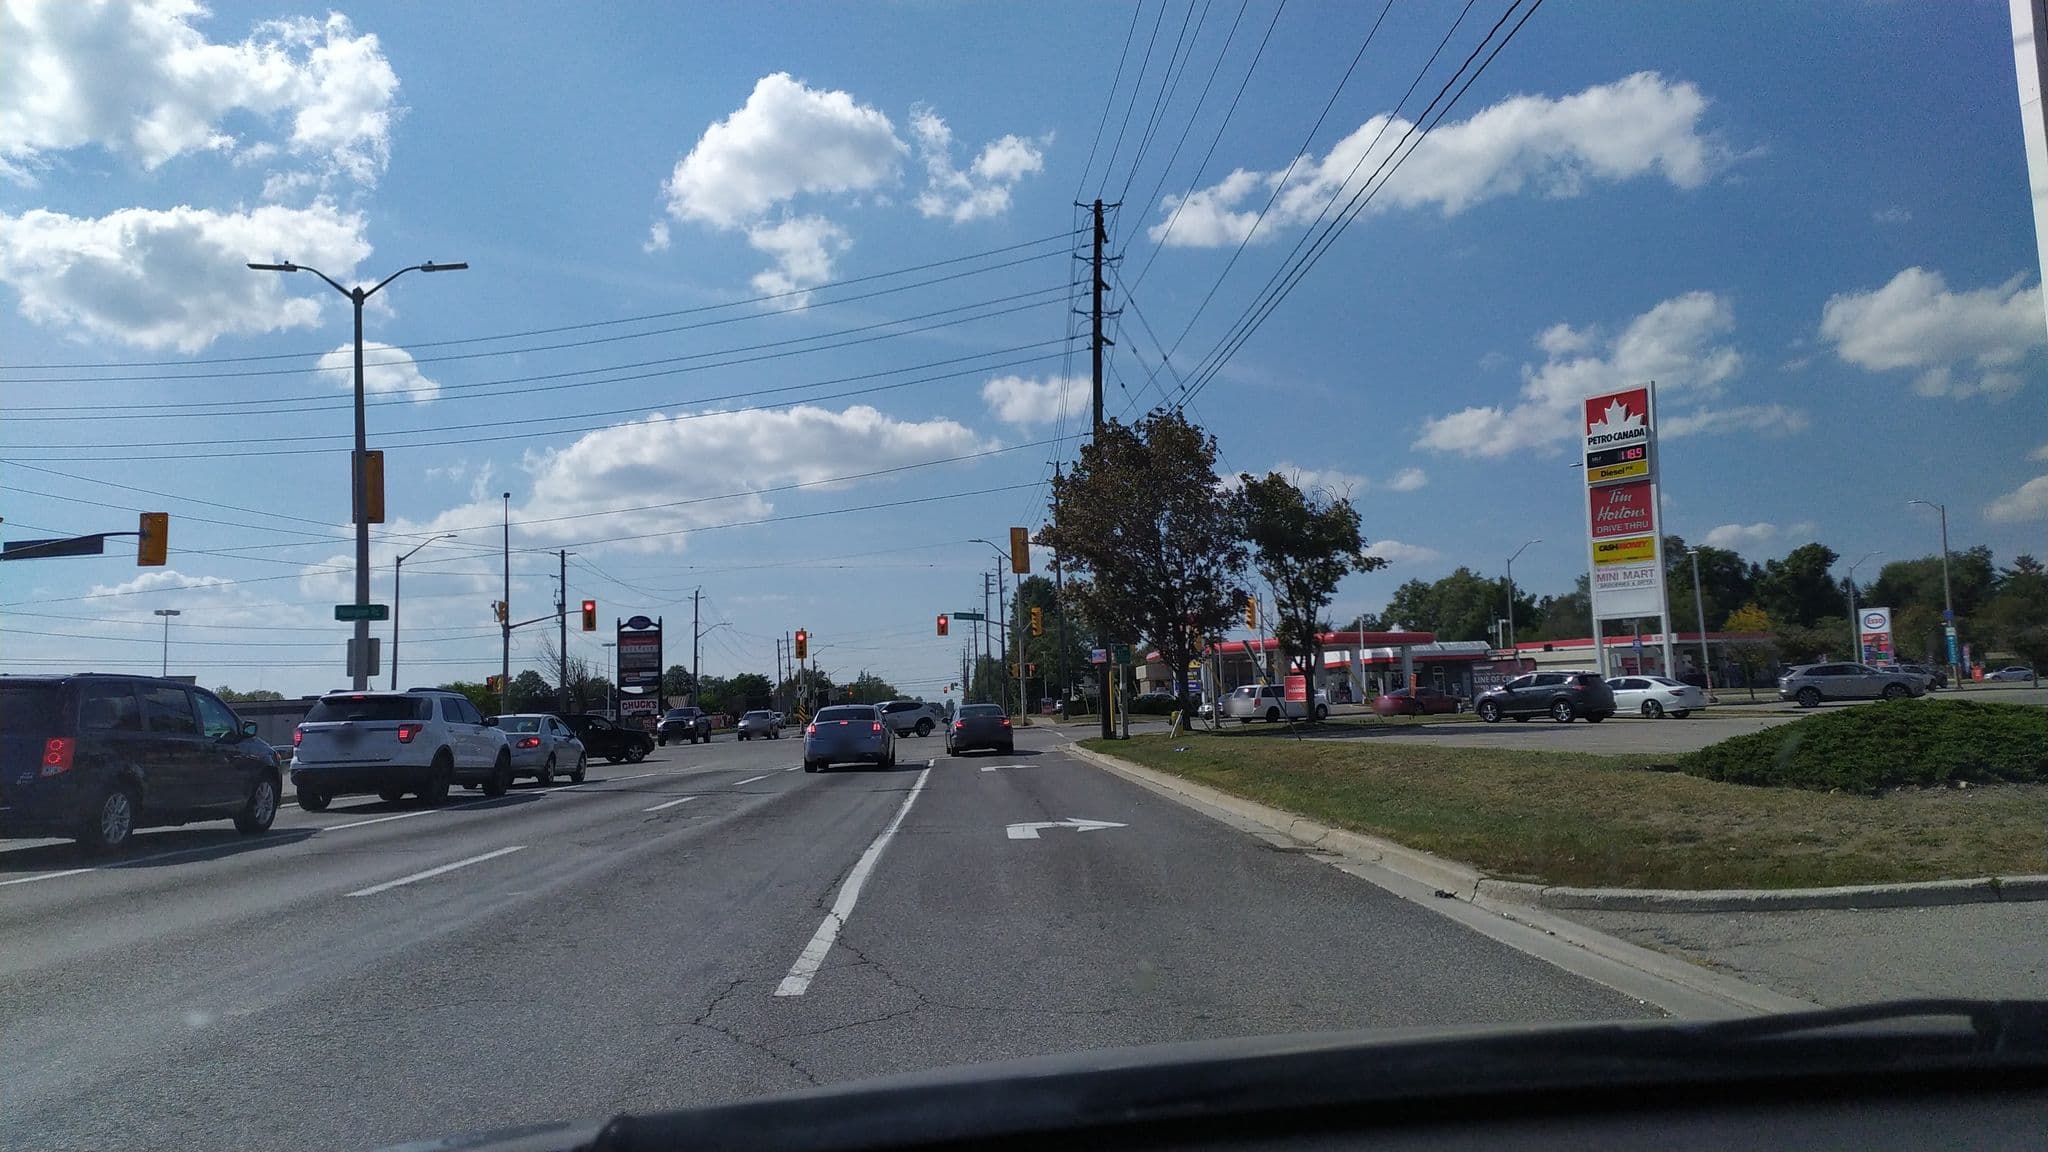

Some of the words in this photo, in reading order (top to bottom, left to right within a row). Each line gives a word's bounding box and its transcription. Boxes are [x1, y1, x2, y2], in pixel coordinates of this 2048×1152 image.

[1601, 468, 1625, 477] Diesel
[1609, 489, 1632, 503] Tim
[1597, 506, 1645, 521] Hortons
[1597, 523, 1624, 533] DRIVE
[1625, 520, 1649, 529] THRU
[1596, 572, 1619, 583] MINI
[1623, 568, 1655, 580] MART
[1867, 617, 1883, 625] Esso
